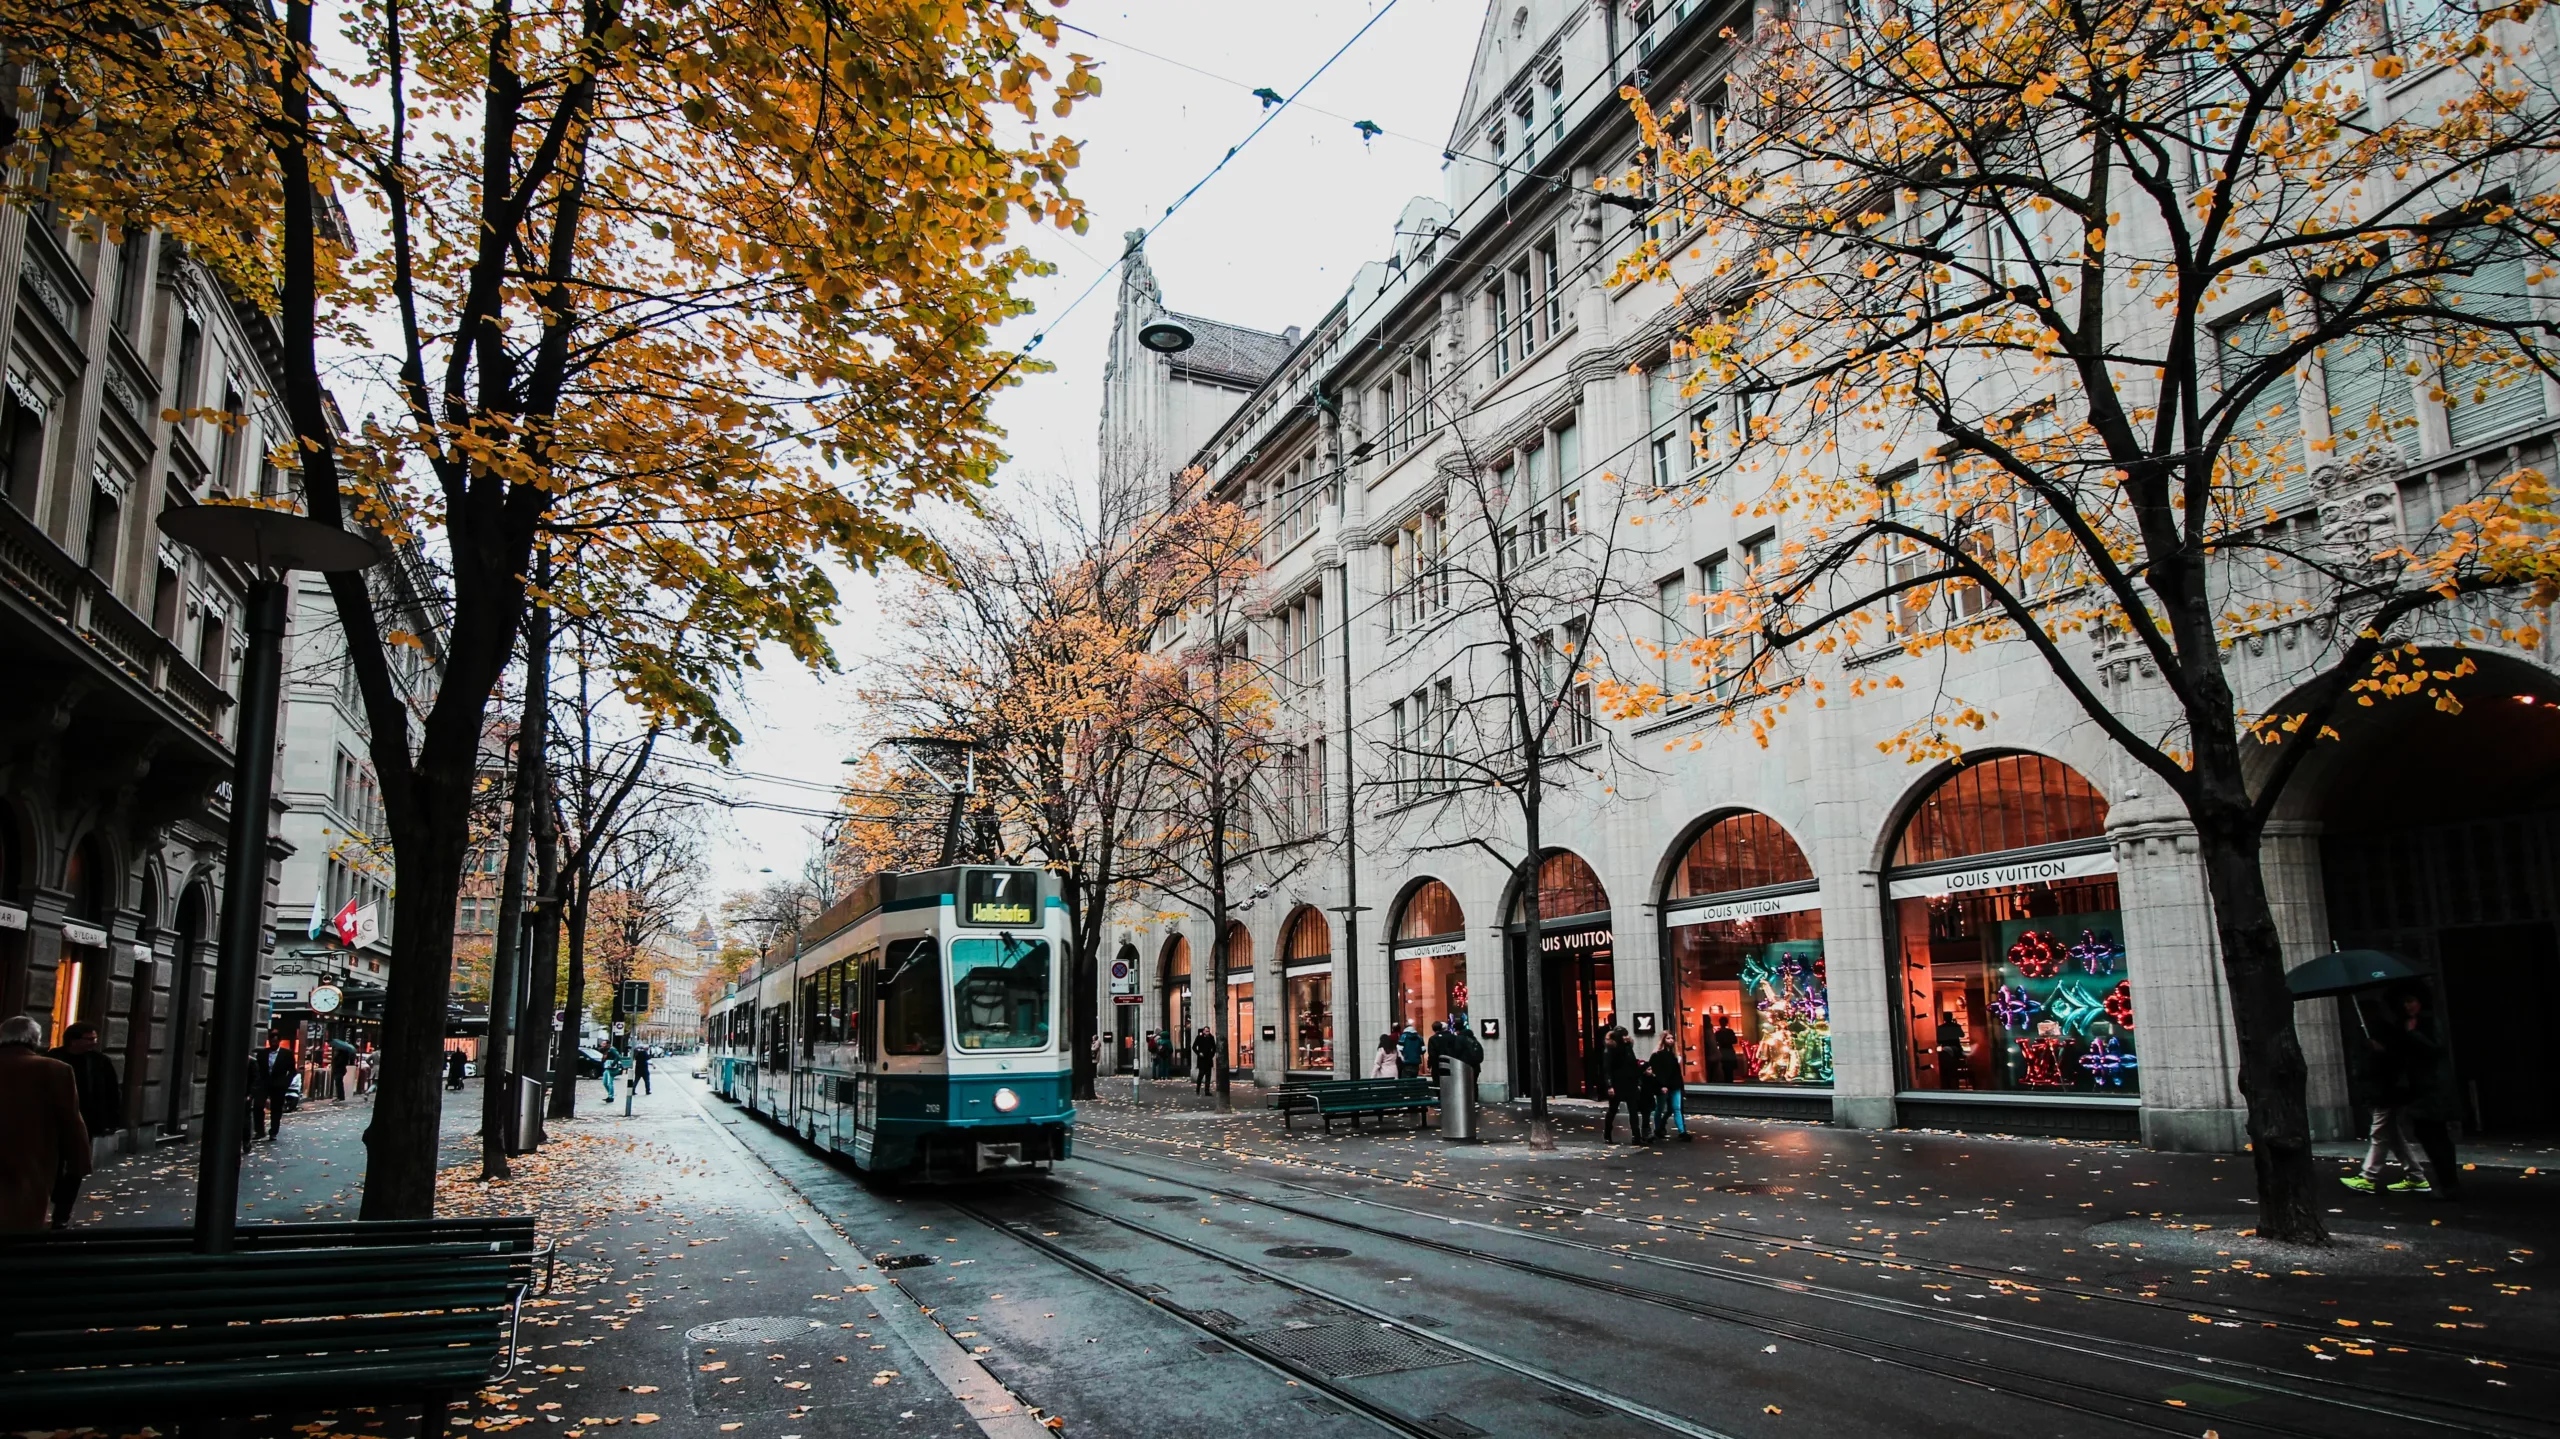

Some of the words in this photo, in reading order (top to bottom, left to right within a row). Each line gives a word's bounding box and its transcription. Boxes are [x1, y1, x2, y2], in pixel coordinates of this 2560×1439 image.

[992, 873, 1012, 898] 7
[1946, 871, 1990, 889] LOUIS
[1995, 861, 2066, 883] VUITTON
[1703, 906, 1732, 920] LOUIS
[1735, 899, 1781, 915] VUITTON
[1414, 946, 1431, 956] LOUIS
[1431, 943, 1457, 955] VUITTON
[1540, 935, 1561, 952] UIS
[1563, 929, 1615, 950] VUITTON
